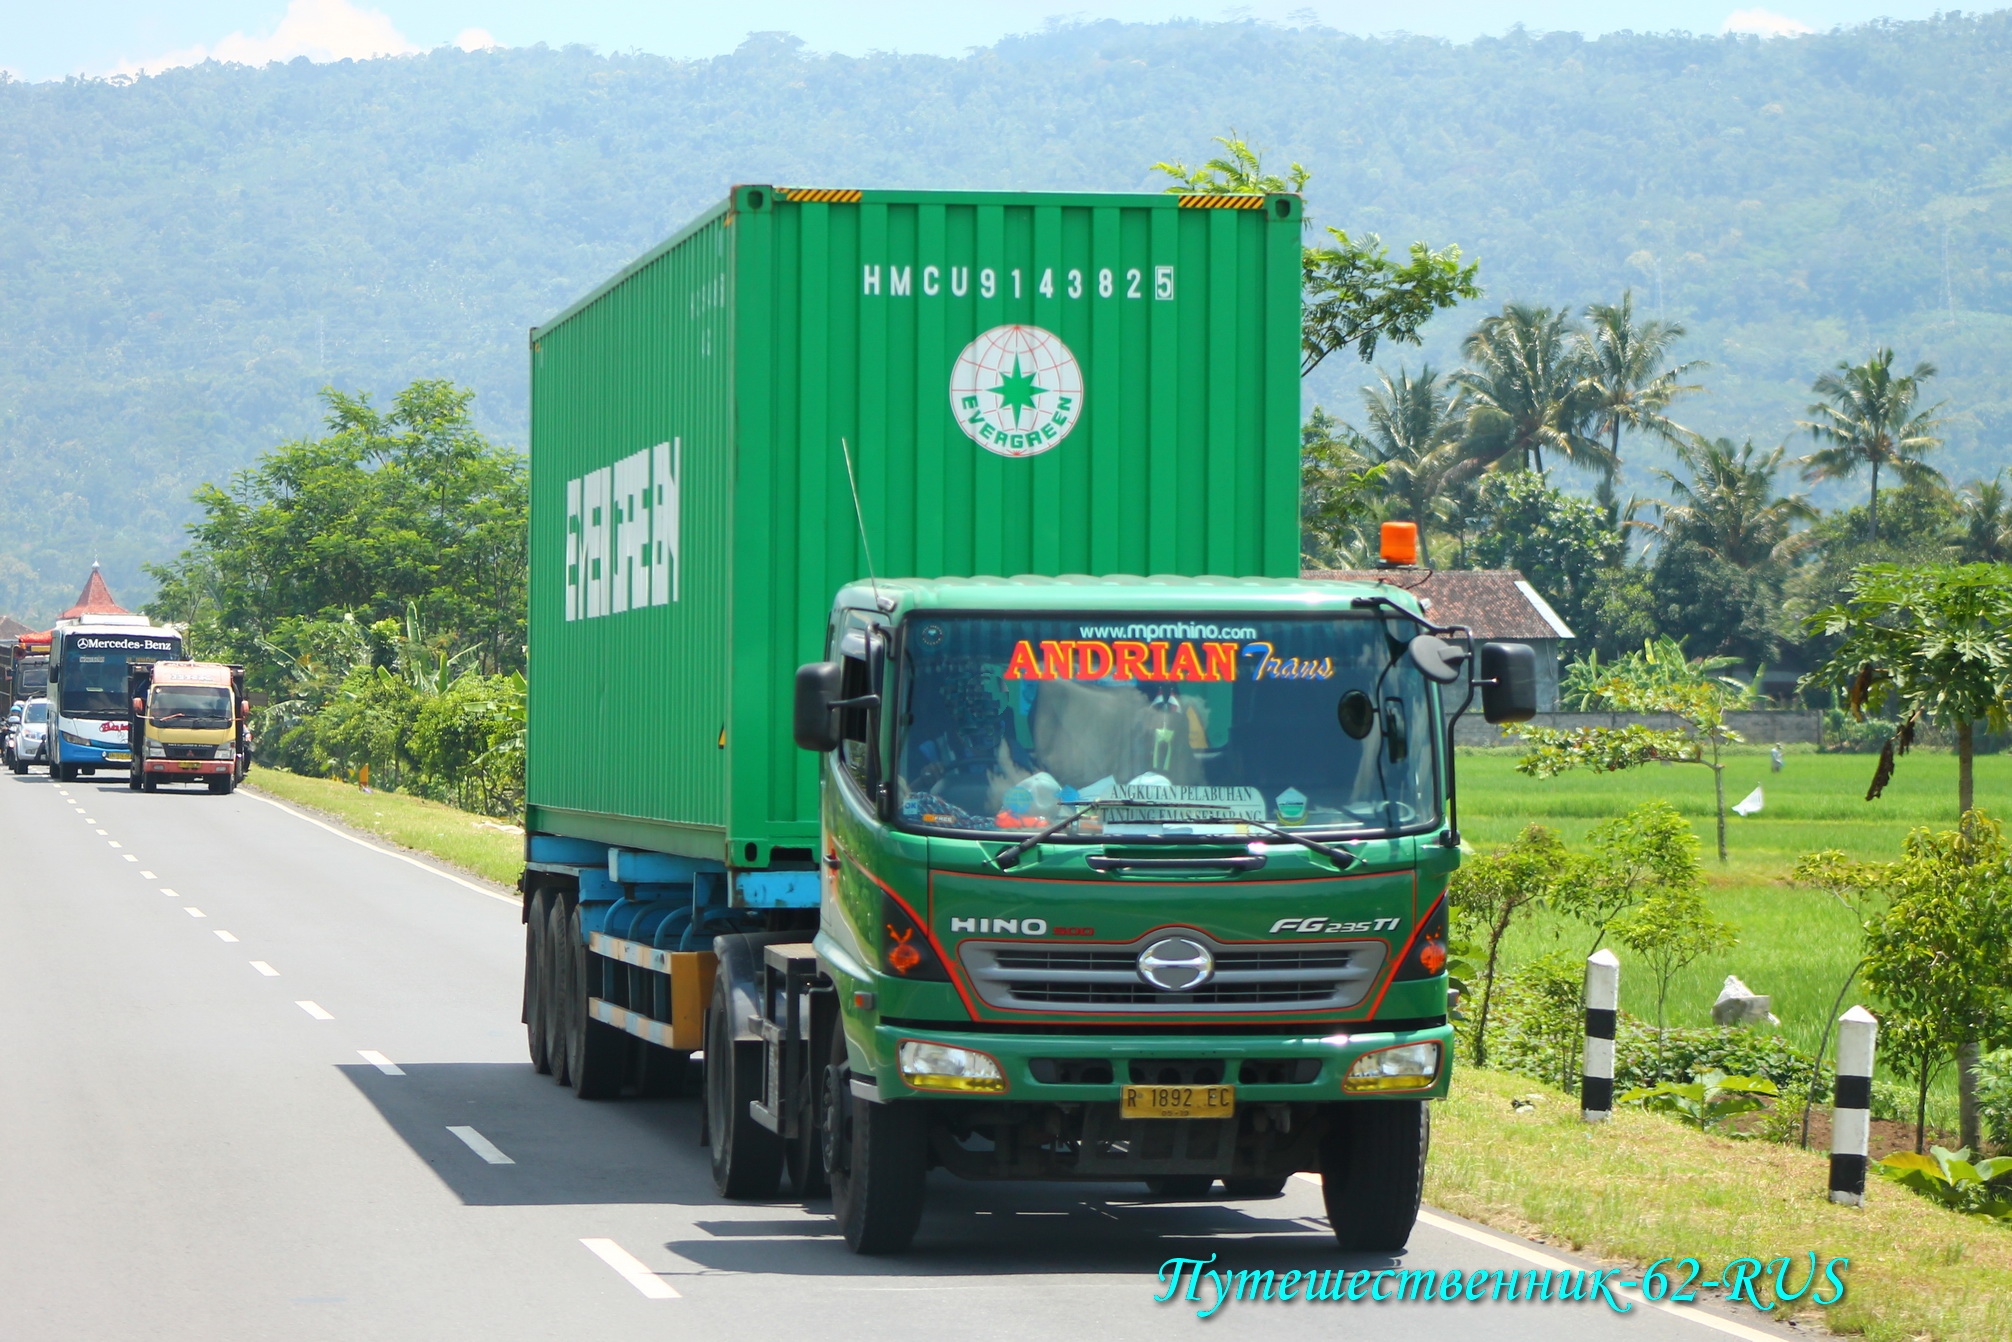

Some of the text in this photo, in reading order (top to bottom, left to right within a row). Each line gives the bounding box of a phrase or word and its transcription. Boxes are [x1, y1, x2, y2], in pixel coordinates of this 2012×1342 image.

[961, 394, 1073, 449] EVERGREEN
[1079, 621, 1257, 643] www.mpmhino.com
[88, 638, 172, 651] Mercedes-Benz
[1003, 640, 1335, 682] ANDRIAN Trans
[1110, 784, 1253, 802] ANGKUTAN PELABUHAN
[951, 917, 1047, 936] HINO
[1127, 1088, 1230, 1108] R 1892 EC
